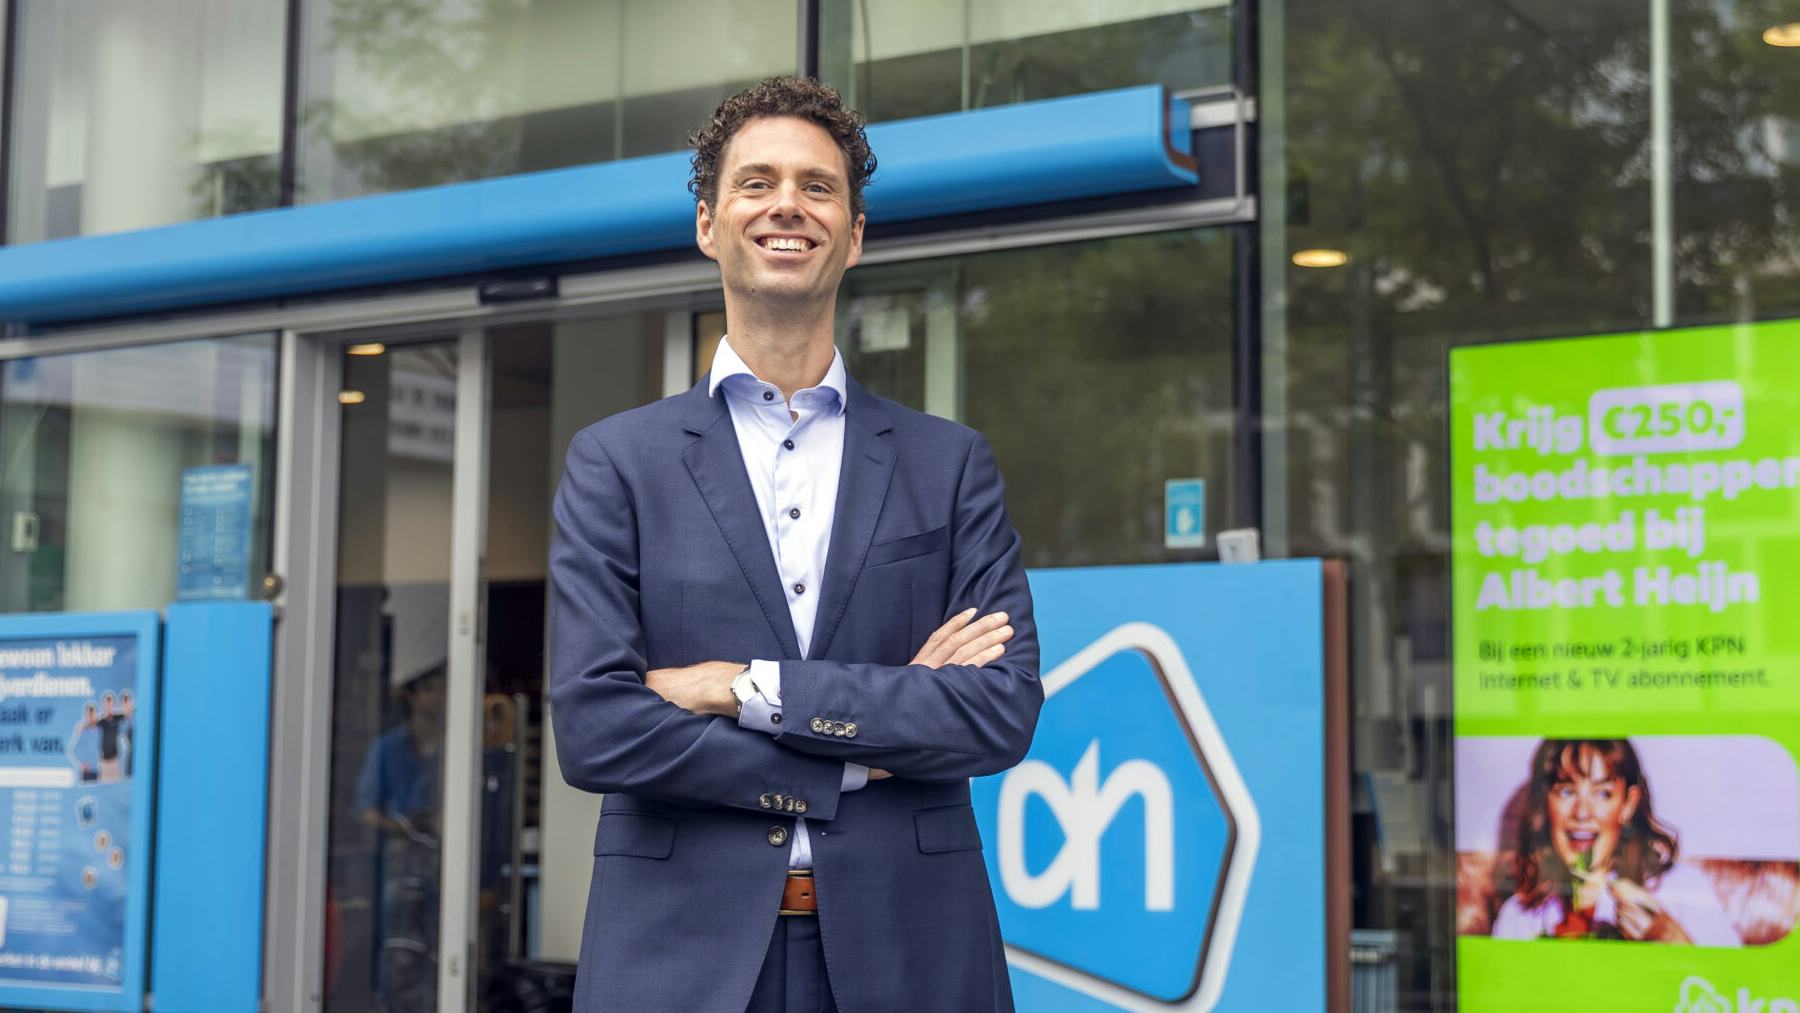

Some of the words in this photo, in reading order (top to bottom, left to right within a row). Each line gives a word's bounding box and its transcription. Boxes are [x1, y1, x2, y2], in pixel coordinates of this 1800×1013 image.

[1474, 405, 1583, 455] Krijg
[1602, 401, 1736, 441] €250,-
[1475, 509, 1635, 564] tegoed
[1645, 507, 1704, 558] bij
[1476, 569, 1625, 612] Albert
[1634, 561, 1760, 614] Heijn
[56, 641, 117, 668] lekker
[1479, 639, 1502, 664] Bij
[1509, 642, 1545, 662] een
[1552, 640, 1615, 660] nieuw
[1620, 636, 1690, 661] 2-jarig
[1694, 635, 1746, 658] KPN
[1479, 671, 1561, 691] Internet
[1567, 669, 1582, 690] &
[1591, 668, 1621, 690] TV
[1626, 667, 1770, 690] abonnement.
[34, 707, 54, 725] er
